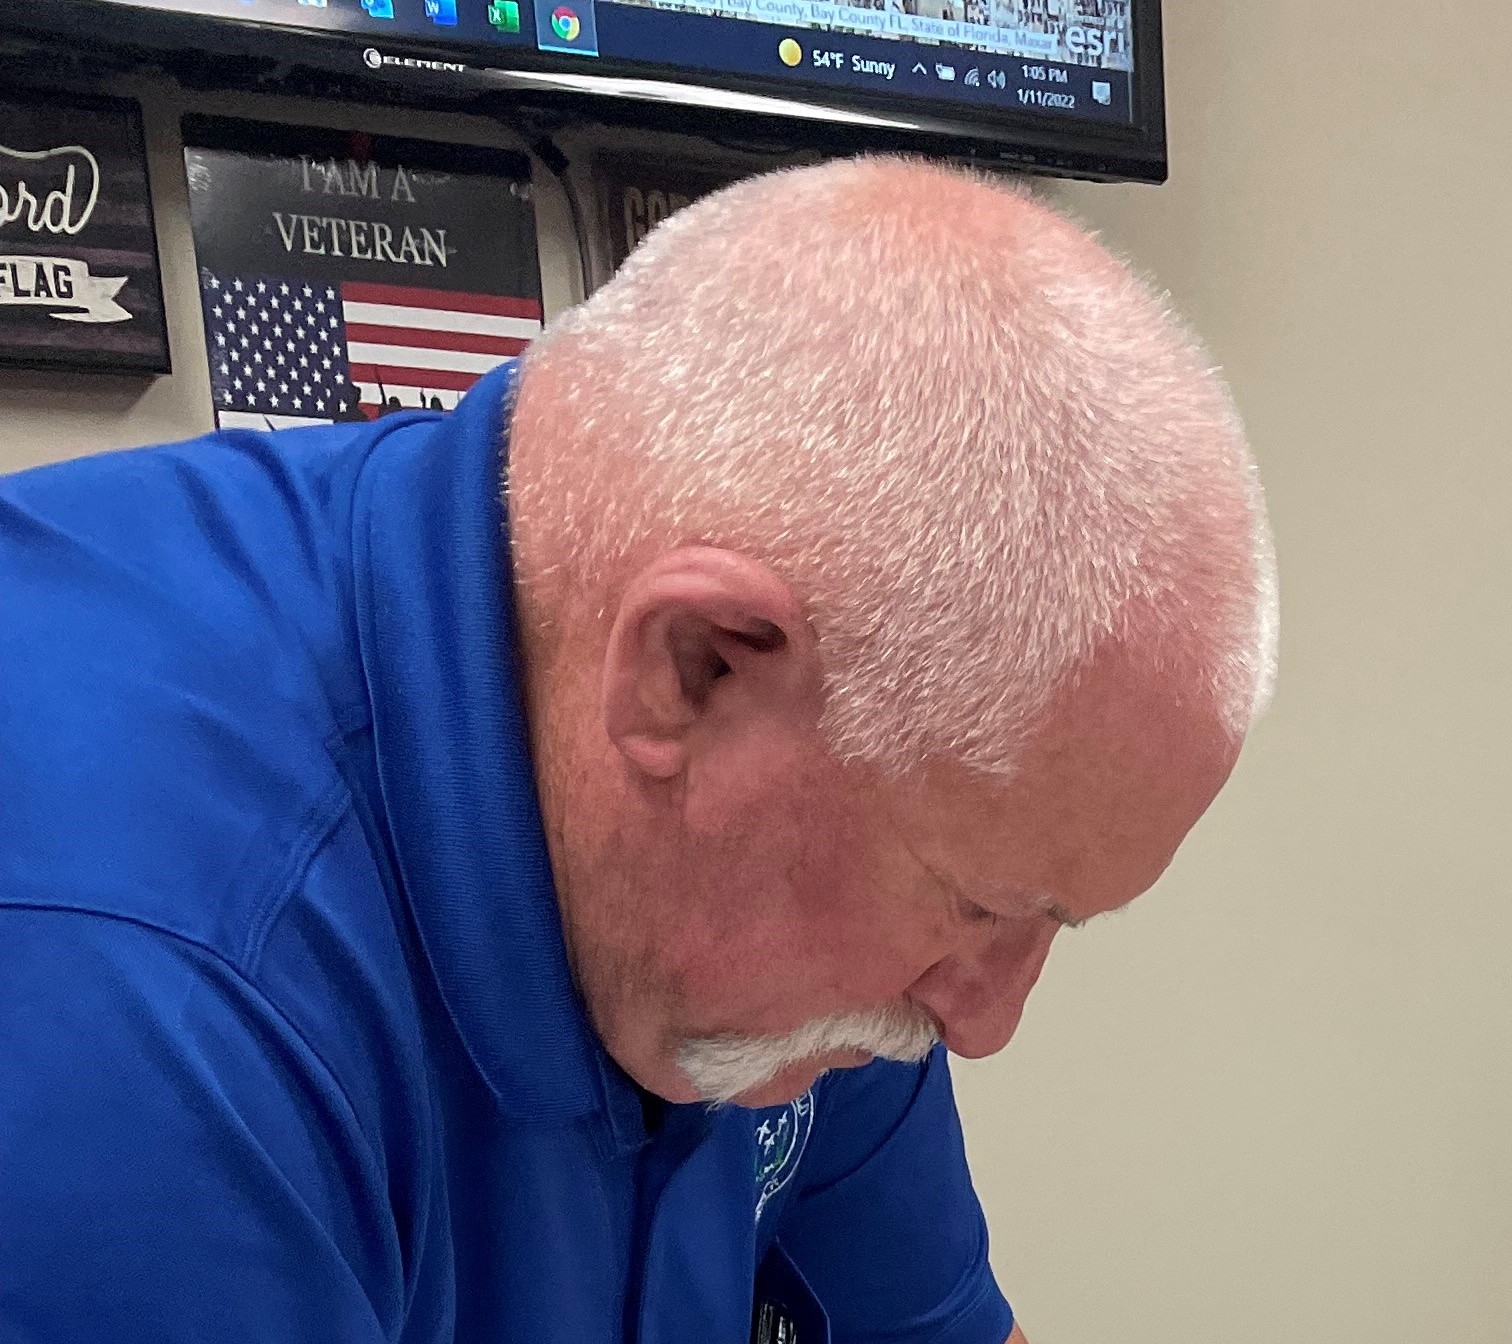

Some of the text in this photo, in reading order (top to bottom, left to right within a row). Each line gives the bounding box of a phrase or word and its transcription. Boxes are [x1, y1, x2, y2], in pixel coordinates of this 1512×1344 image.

[811, 8, 834, 24] Bay
[838, 10, 887, 29] County
[911, 18, 944, 35] State
[1065, 22, 1125, 57] esri
[383, 56, 466, 73] ELEMENT
[812, 49, 895, 80] 54°F Sunny
[1021, 64, 1068, 84] 1:05 PM
[1016, 88, 1076, 109] 1/11/2022
[391, 164, 415, 203] A
[272, 211, 449, 269] VETERAN
